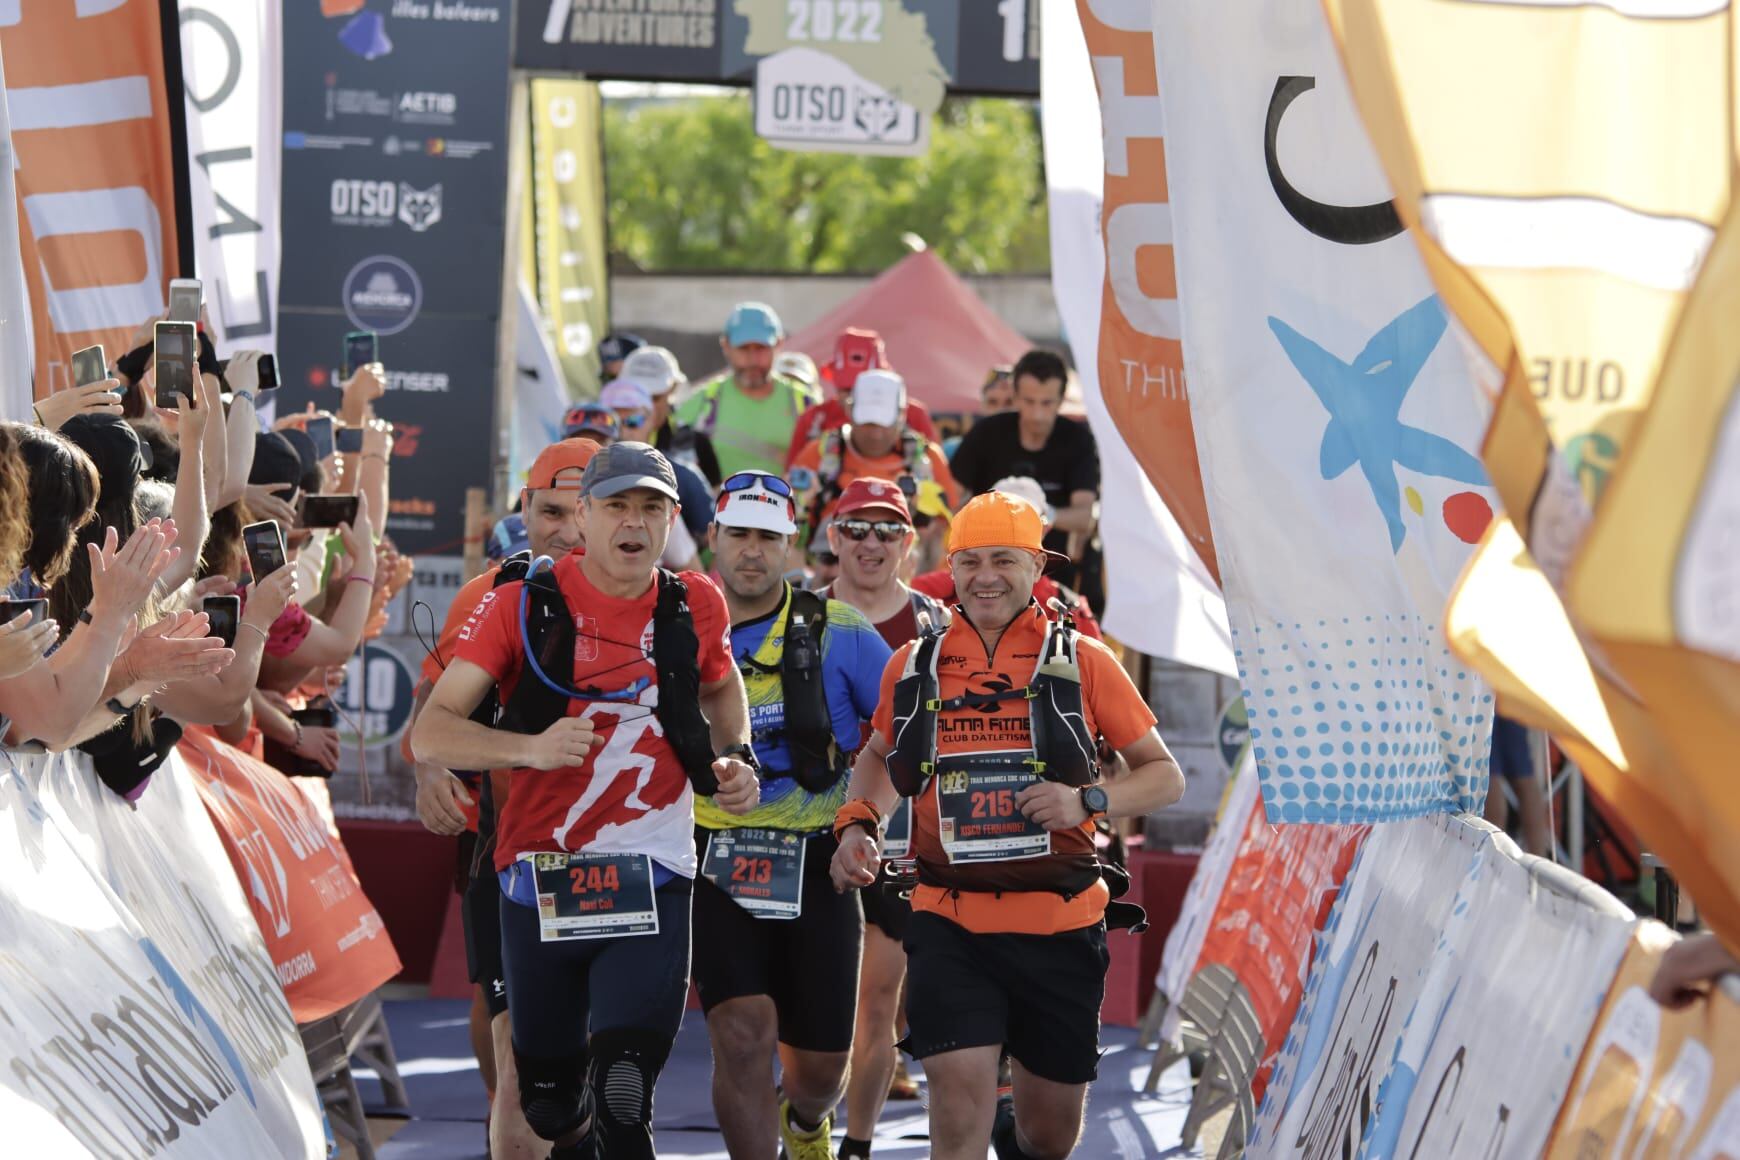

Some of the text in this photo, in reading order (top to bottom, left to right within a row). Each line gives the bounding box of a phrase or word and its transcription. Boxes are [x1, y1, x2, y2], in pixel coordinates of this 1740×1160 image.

[570, 13, 715, 48] ADVENTURES
[786, 0, 882, 42] 2022
[400, 91, 456, 114] AETIB
[774, 84, 845, 122] OTSO
[330, 178, 396, 217] OTSO
[738, 492, 778, 506] IRONMAN
[942, 733, 968, 743] CLUB
[970, 789, 1014, 818] 215
[569, 864, 620, 895] 244
[731, 856, 773, 884] 213
[276, 949, 317, 987] NDORRA
